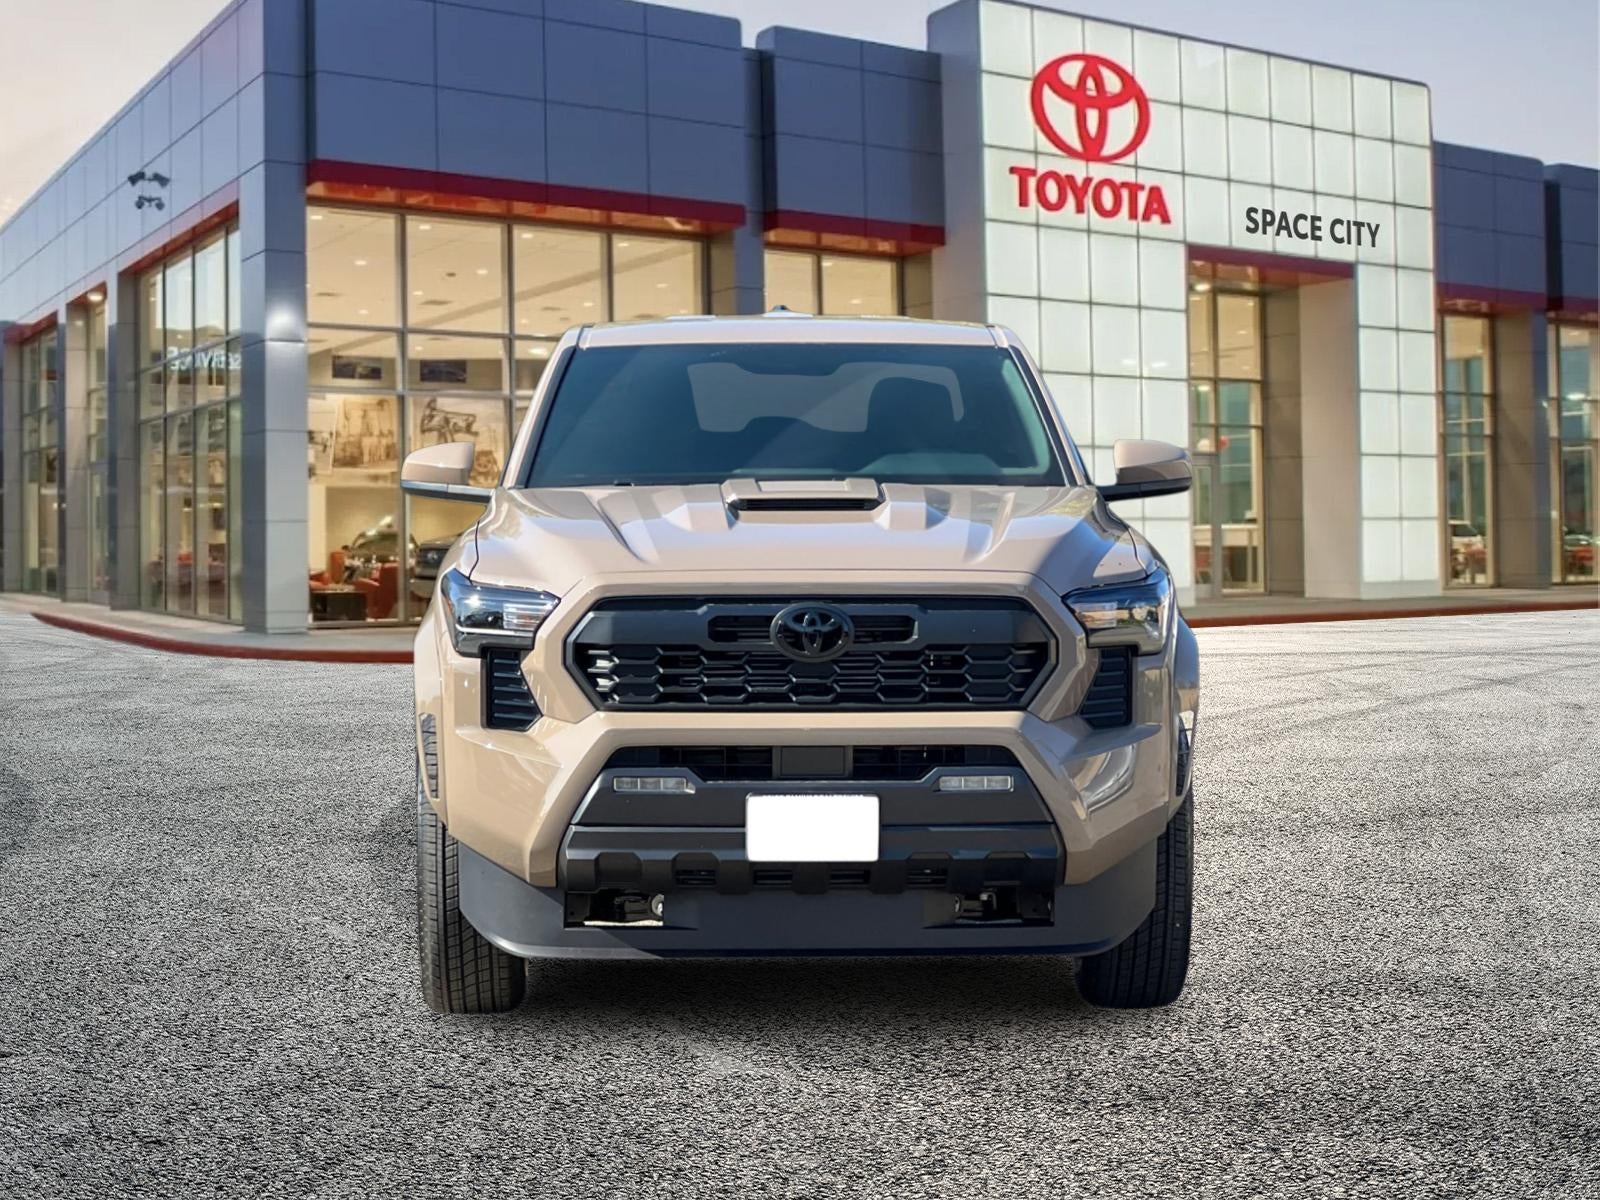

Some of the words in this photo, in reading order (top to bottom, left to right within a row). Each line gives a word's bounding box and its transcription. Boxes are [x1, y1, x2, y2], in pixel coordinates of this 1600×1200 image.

[1009, 166, 1172, 225] TOYOTA
[1245, 206, 1323, 242] SPACE
[1329, 218, 1381, 248] CITY
